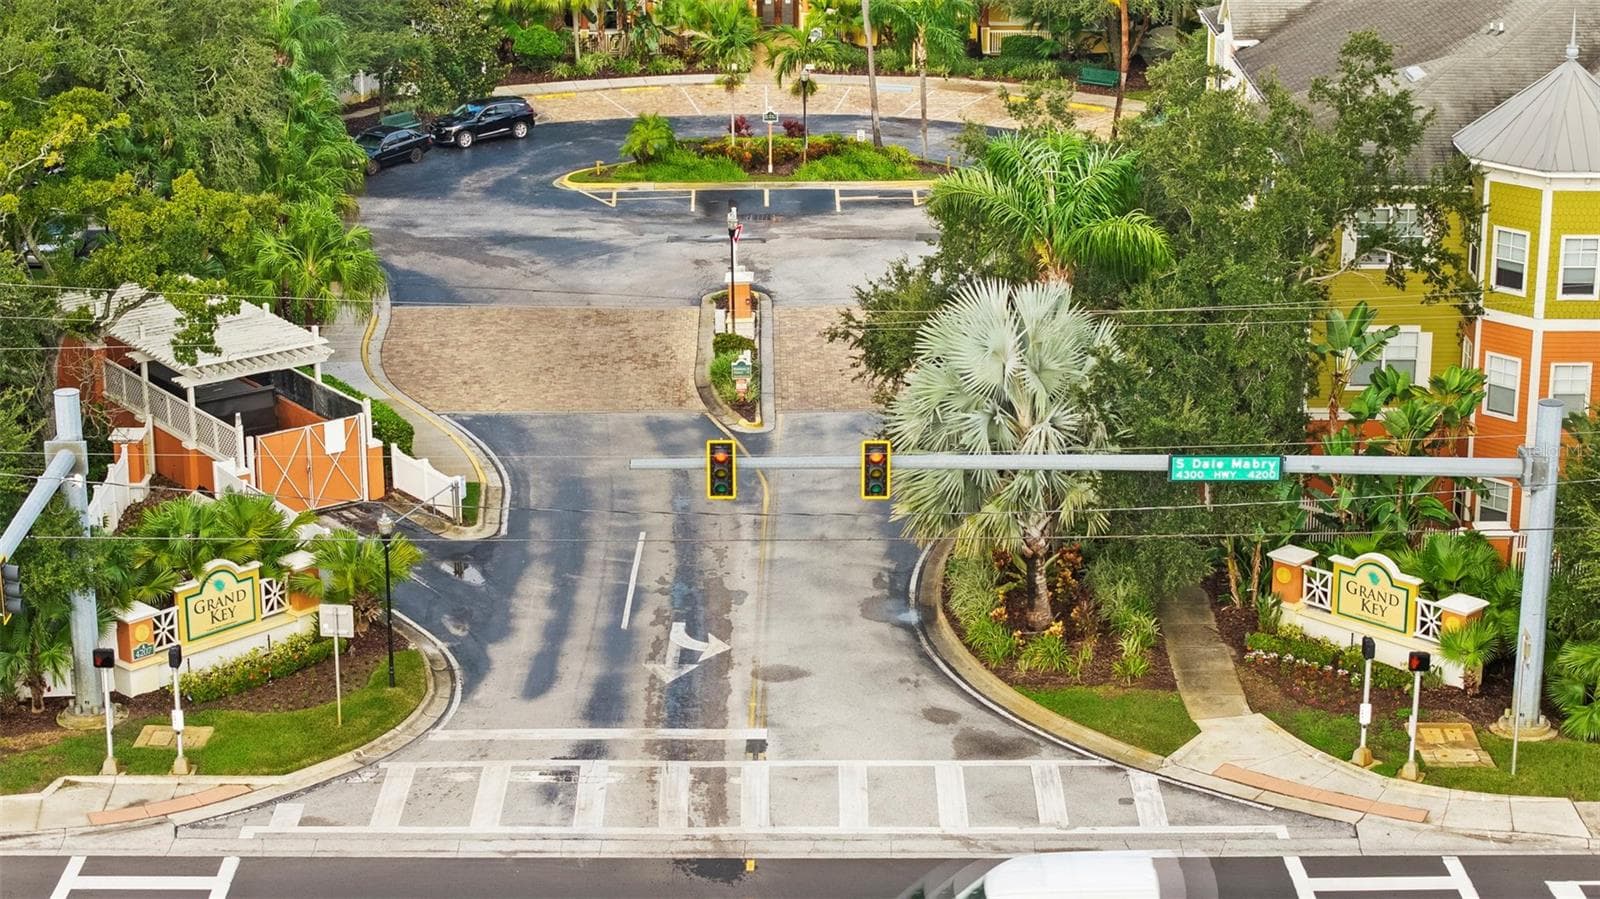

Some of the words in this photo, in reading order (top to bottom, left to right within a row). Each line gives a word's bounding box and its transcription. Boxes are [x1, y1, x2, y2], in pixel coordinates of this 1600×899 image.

[1176, 459, 1184, 468] S
[1192, 459, 1225, 469] Dale
[1231, 459, 1277, 472] Mabry
[1176, 471, 1204, 479] 4300
[1214, 471, 1237, 479] HWY
[1247, 471, 1276, 479] 4200
[194, 589, 247, 614] GRAND
[1346, 580, 1400, 607] GRAND
[210, 605, 236, 624] KEY
[1361, 598, 1388, 617] KEY
